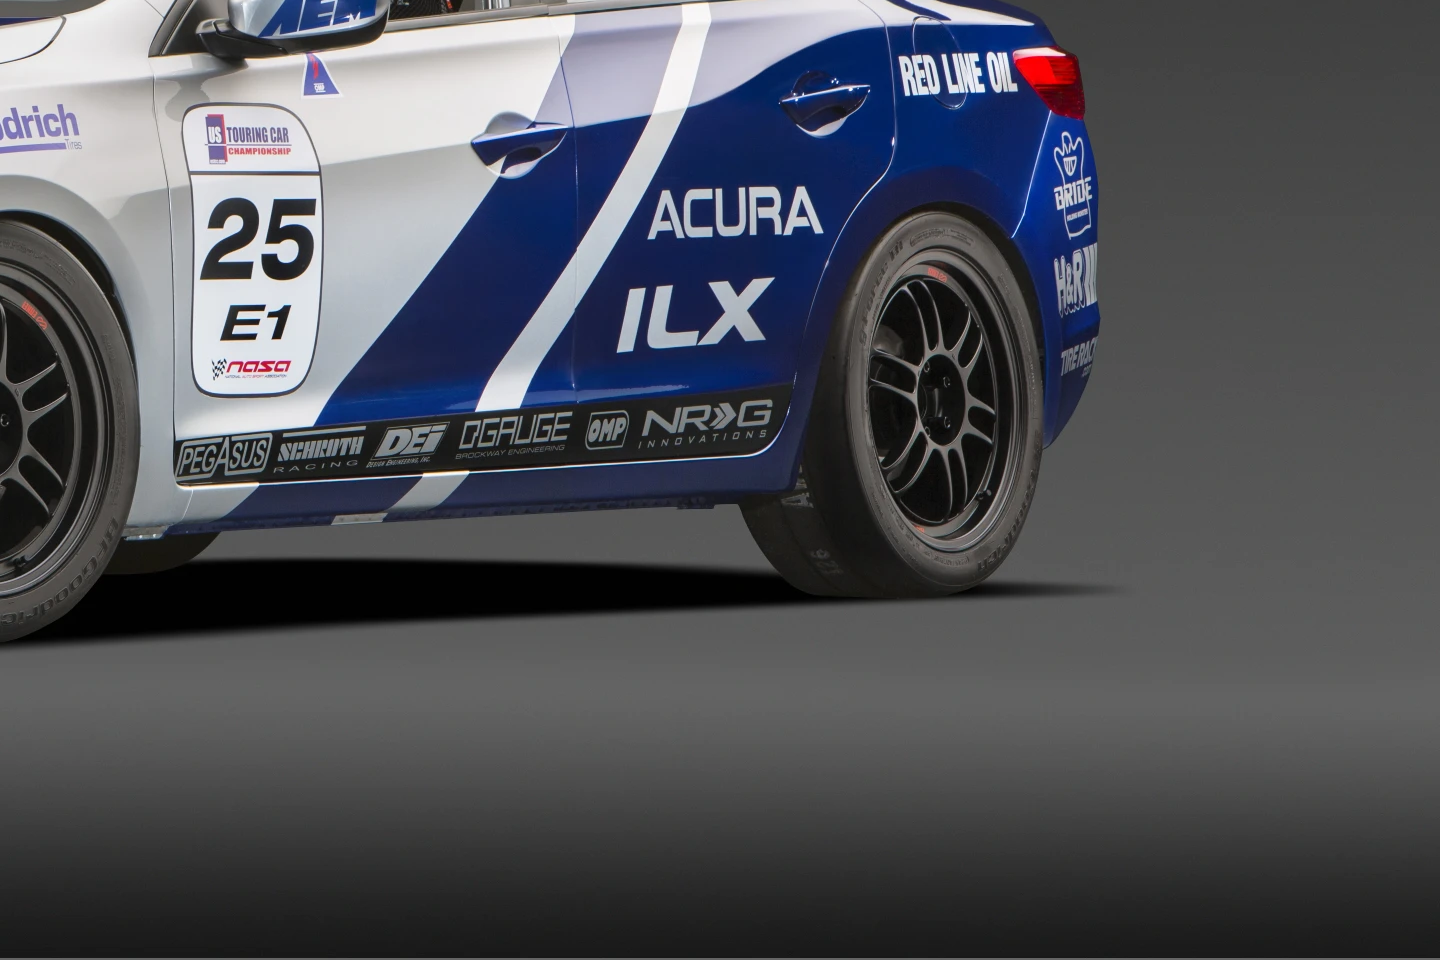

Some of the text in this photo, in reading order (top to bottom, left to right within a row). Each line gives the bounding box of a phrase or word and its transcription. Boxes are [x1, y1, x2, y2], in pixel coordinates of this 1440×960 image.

[898, 51, 1018, 97] RED LINE OIL
[64, 138, 83, 150] Tires
[208, 126, 223, 144] US
[226, 126, 289, 143] TOURING CAR
[228, 147, 291, 155] CHAMPIONSHIP
[1053, 176, 1093, 210] BRIDE
[647, 186, 824, 240] ACURA
[200, 197, 317, 281] 25
[1054, 248, 1085, 313] H&R
[219, 304, 292, 342] E1
[616, 277, 776, 353] ILX
[226, 360, 292, 373] nasa
[1060, 344, 1079, 376] TIRE
[588, 417, 627, 443] OMP
[637, 429, 768, 449] INNOVATIONS
[178, 436, 267, 475] PEGASUS
[277, 436, 365, 462] SCHROTH
[455, 444, 566, 461] BROCKWAY ENGINEERING
[272, 460, 359, 474] RACING
